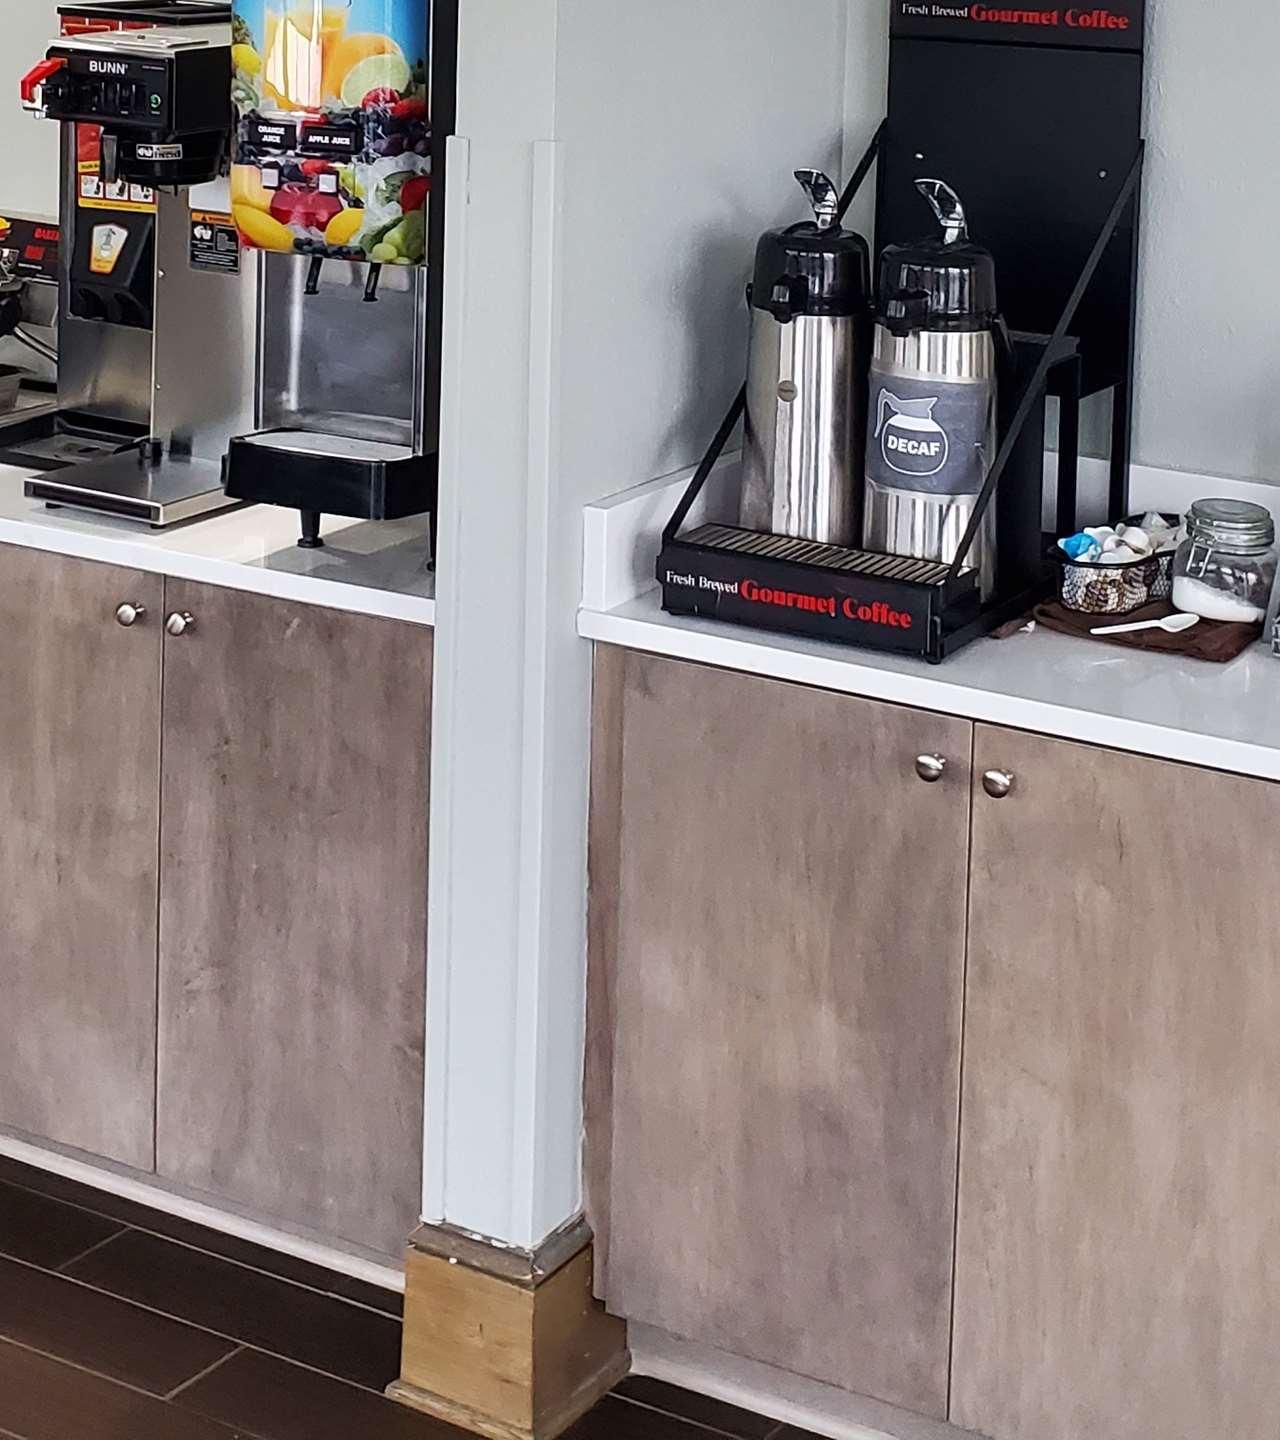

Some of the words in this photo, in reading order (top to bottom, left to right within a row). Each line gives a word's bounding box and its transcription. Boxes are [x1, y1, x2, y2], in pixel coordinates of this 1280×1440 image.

[902, 3, 928, 16] Fresh
[932, 4, 968, 18] Brewed
[971, 4, 1058, 25] Gourmet
[1065, 9, 1129, 29] Coffee
[89, 61, 126, 74] BUNN
[308, 135, 329, 144] APPLE
[887, 434, 940, 457] DECAF
[666, 570, 695, 587] Fresh
[699, 576, 738, 594] Brewed
[740, 579, 835, 616] Gourmet
[842, 597, 912, 629] Coffee
